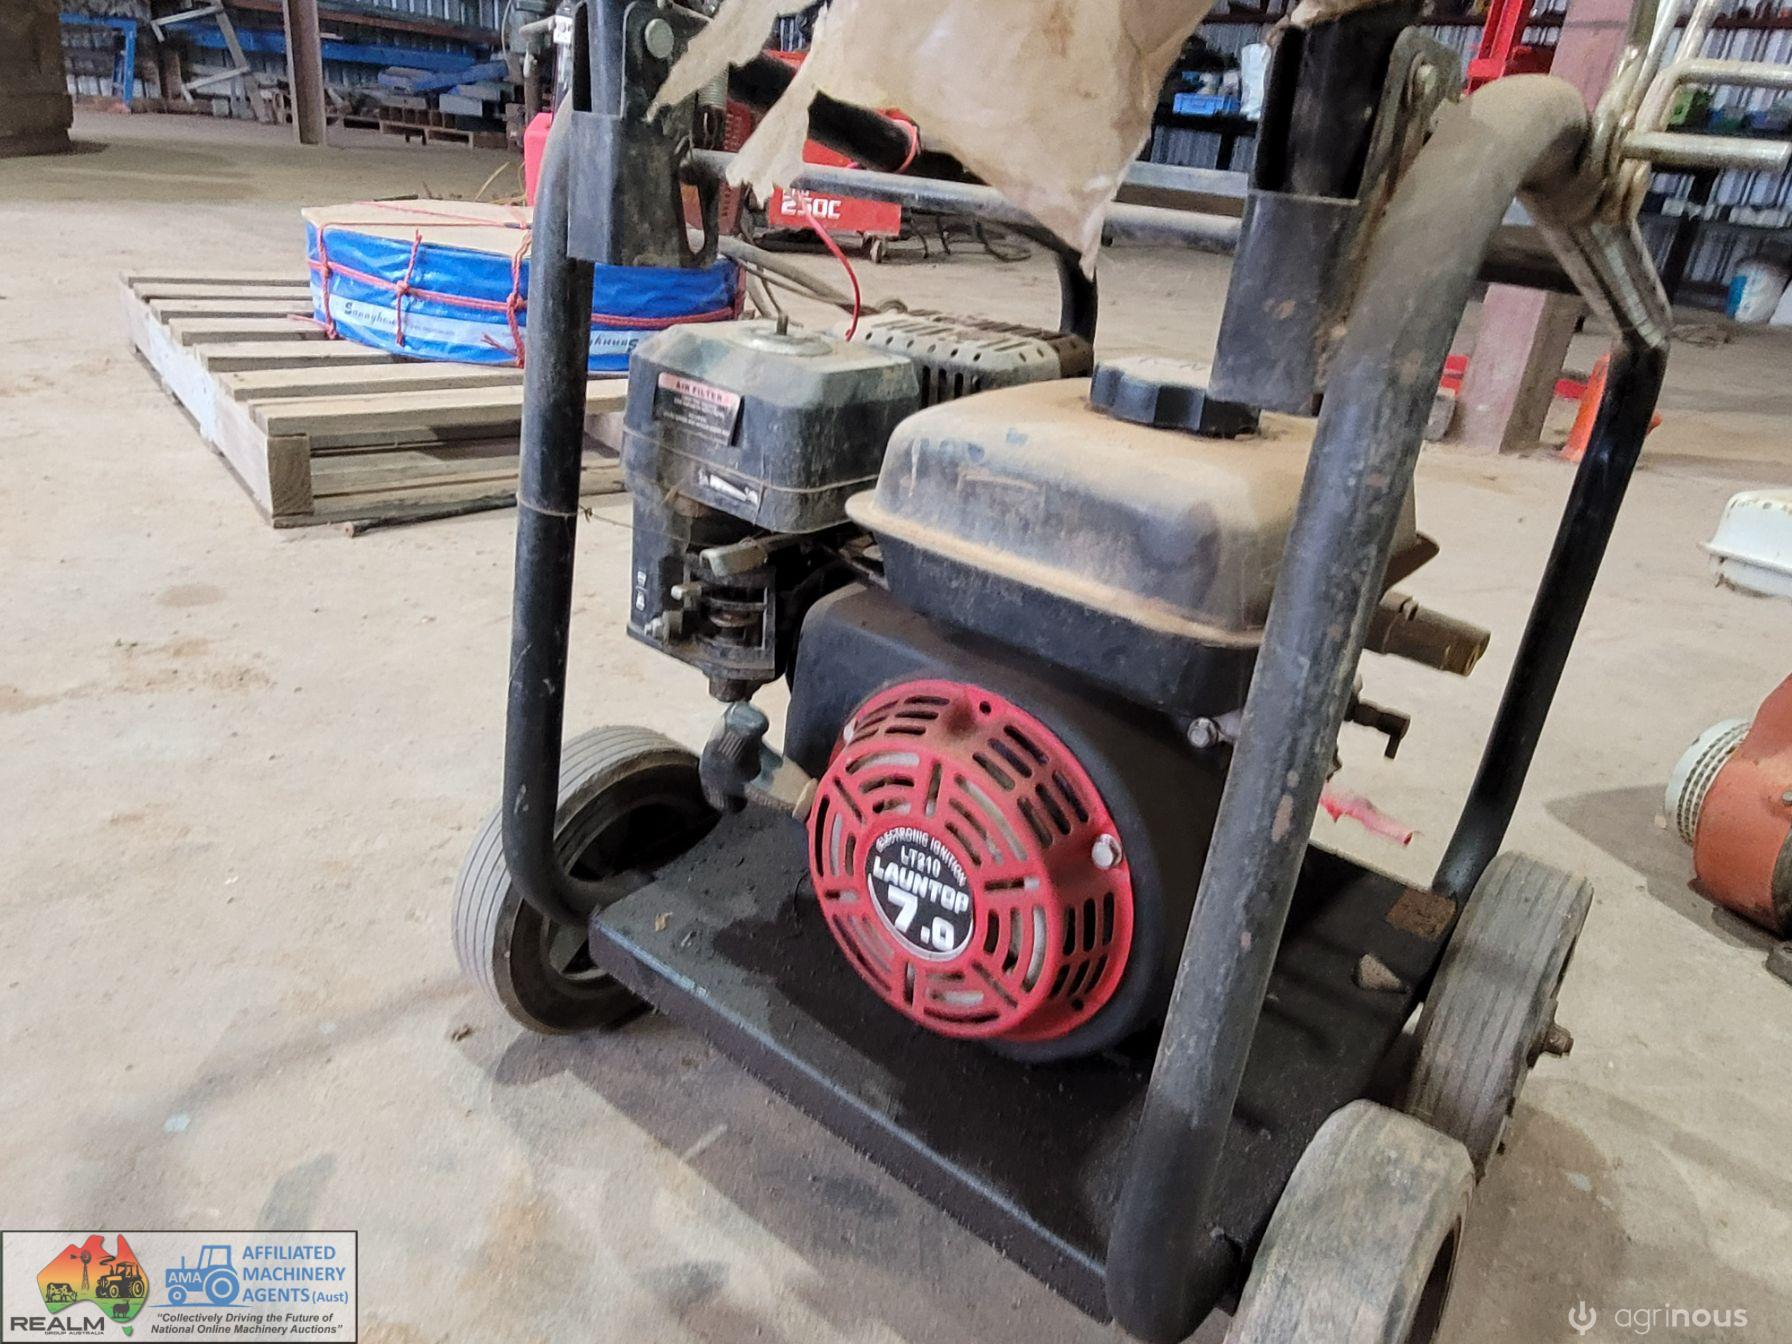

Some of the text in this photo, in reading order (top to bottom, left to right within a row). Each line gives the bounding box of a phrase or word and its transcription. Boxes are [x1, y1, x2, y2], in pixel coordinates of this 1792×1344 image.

[781, 195, 841, 219] 250C
[676, 381, 722, 401] AIR FILTER
[873, 855, 970, 914] LAUNTOP
[930, 837, 967, 887] IGNITION
[888, 884, 955, 952] 7.0
